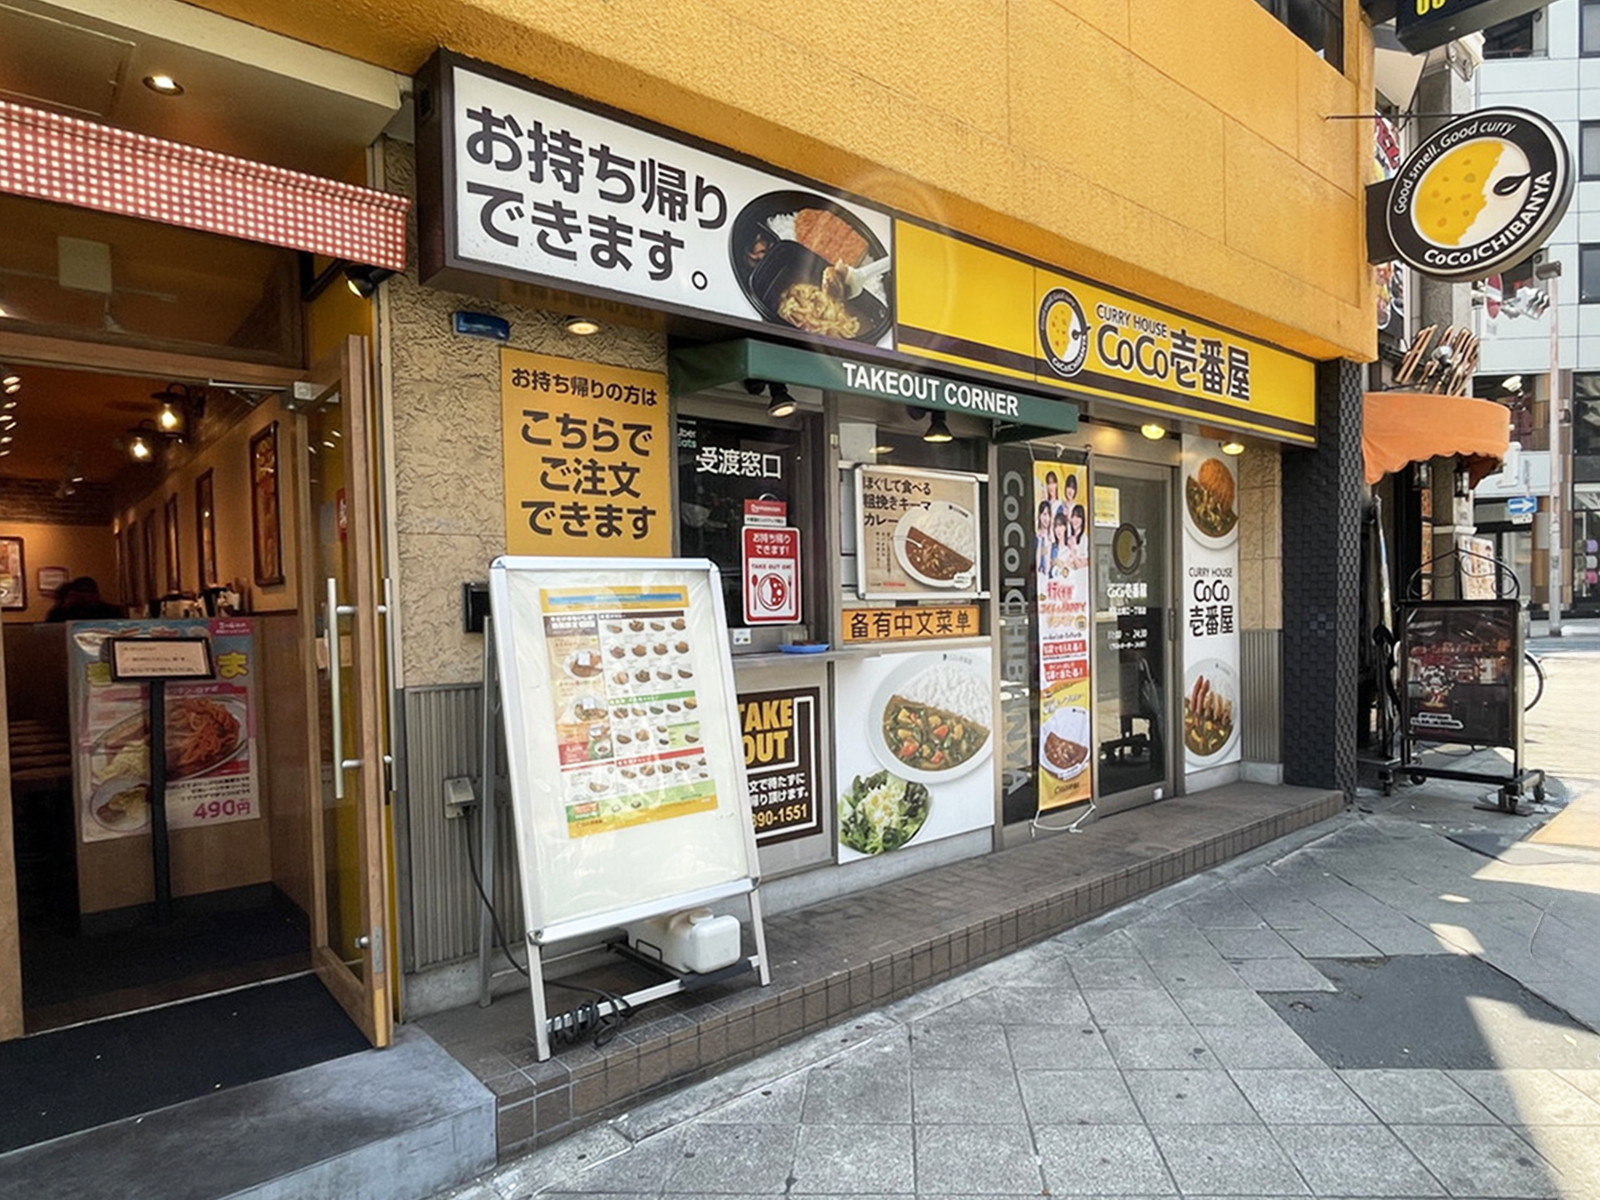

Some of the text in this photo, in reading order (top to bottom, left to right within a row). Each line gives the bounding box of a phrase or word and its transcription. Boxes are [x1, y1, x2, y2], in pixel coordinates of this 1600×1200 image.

[466, 106, 728, 231] お持ち帰り
[1393, 120, 1517, 215] Good smell. Good curry
[466, 180, 709, 292] できます。
[1096, 303, 1130, 330] CURRY
[1133, 314, 1168, 339] HOUSE
[1096, 323, 1252, 402] CoCo壱番屋
[511, 367, 659, 408] お持ち帰りの方は
[842, 361, 1019, 417] TAKEOUT CORNER
[521, 409, 654, 457] こちらで
[539, 456, 642, 499] ご注文
[695, 446, 782, 480] 受渡窓口
[863, 476, 932, 496] ほぐして食べる
[521, 500, 656, 540] できます
[864, 513, 900, 527] カレー
[1188, 566, 1233, 577] CURRY HOUSE
[1193, 579, 1230, 603] CoCo
[1189, 604, 1234, 637] 壱番屋
[193, 799, 251, 820] 490円
